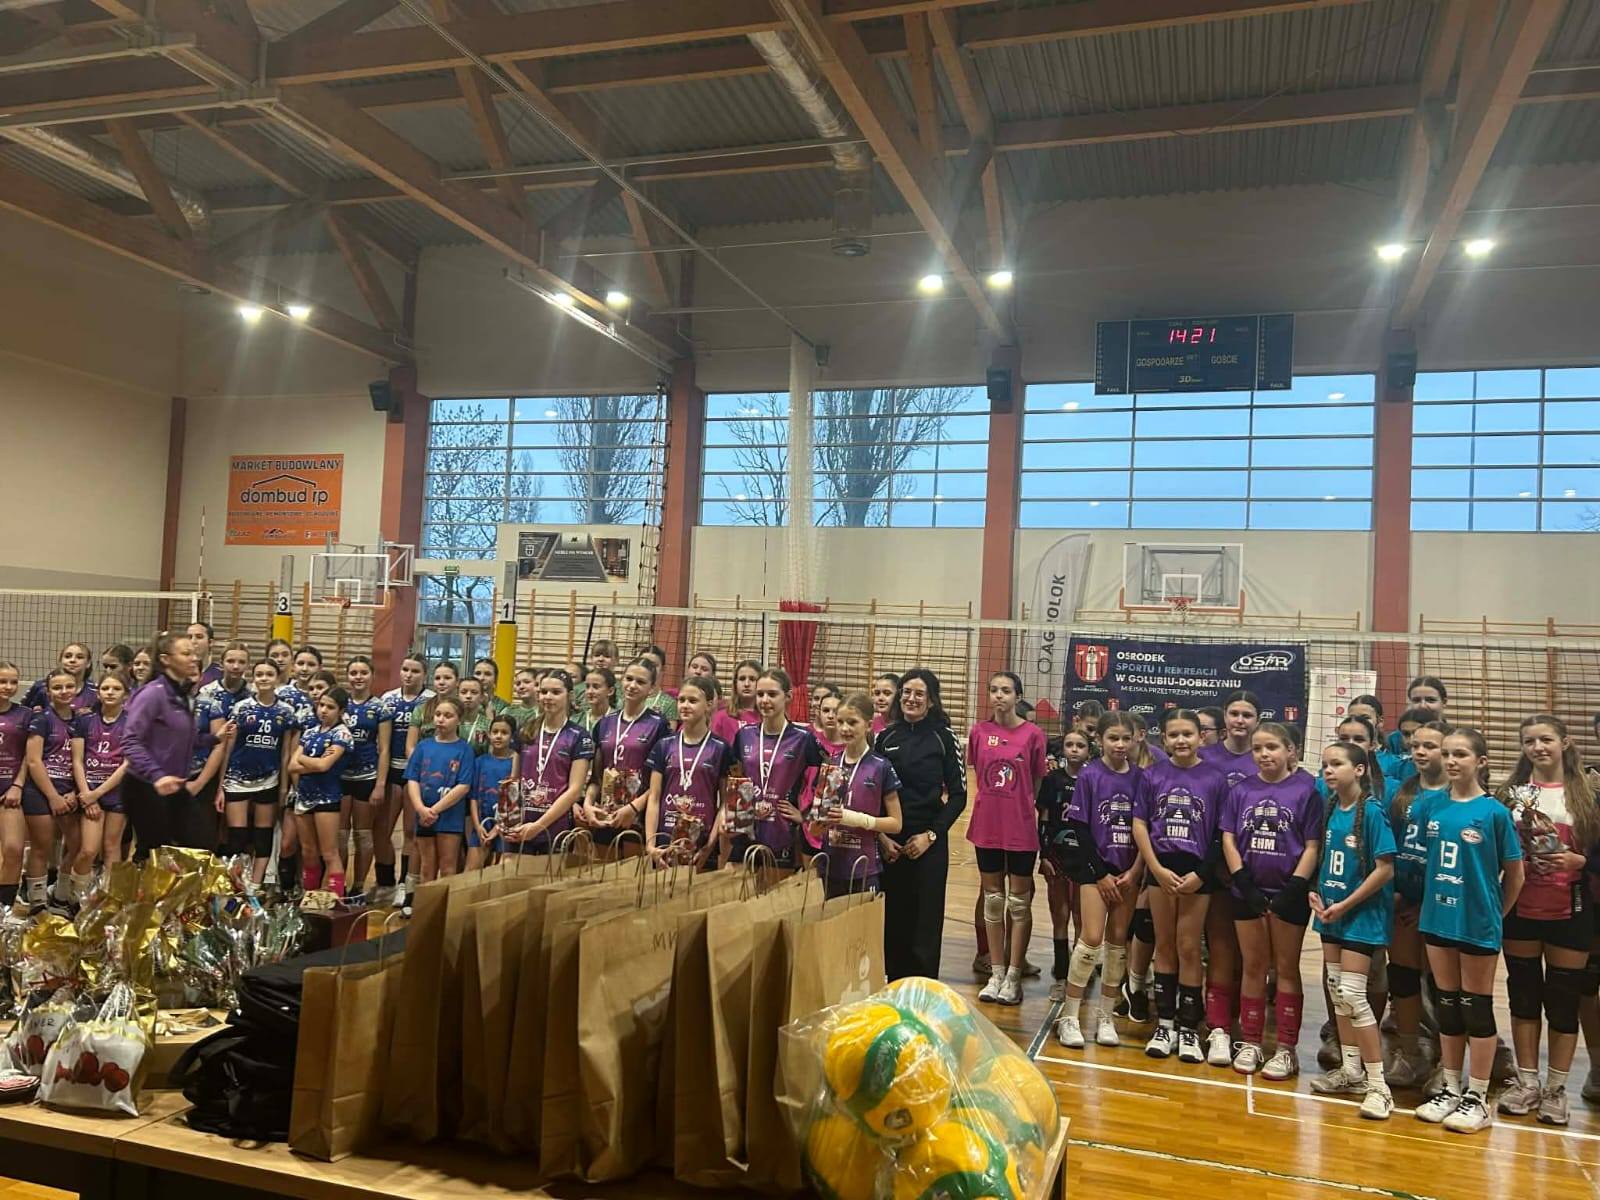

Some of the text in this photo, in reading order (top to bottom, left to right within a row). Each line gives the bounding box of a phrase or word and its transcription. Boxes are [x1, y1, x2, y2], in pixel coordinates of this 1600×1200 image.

[1135, 356, 1184, 367] GOSPODARZE
[231, 459, 340, 471] MARKET BUDOWLANY
[240, 488, 307, 503] dombud
[279, 596, 288, 611] 3
[503, 602, 510, 618] 1
[1040, 574, 1066, 656] AGOLOK
[1115, 662, 1155, 673] SPORTU
[1164, 666, 1217, 676] REKREACJI
[1115, 673, 1241, 688] W GOLUBIU-DOBRZYNIU
[1120, 685, 1148, 693] MIEJSKA
[1190, 689, 1218, 697] SPORTU
[395, 711, 412, 723] 28
[258, 719, 272, 733] 26
[97, 740, 110, 753] 12
[1166, 825, 1190, 838] EHM
[1251, 837, 1276, 850] EHM
[1440, 840, 1459, 869] 13
[1329, 849, 1345, 876] 18
